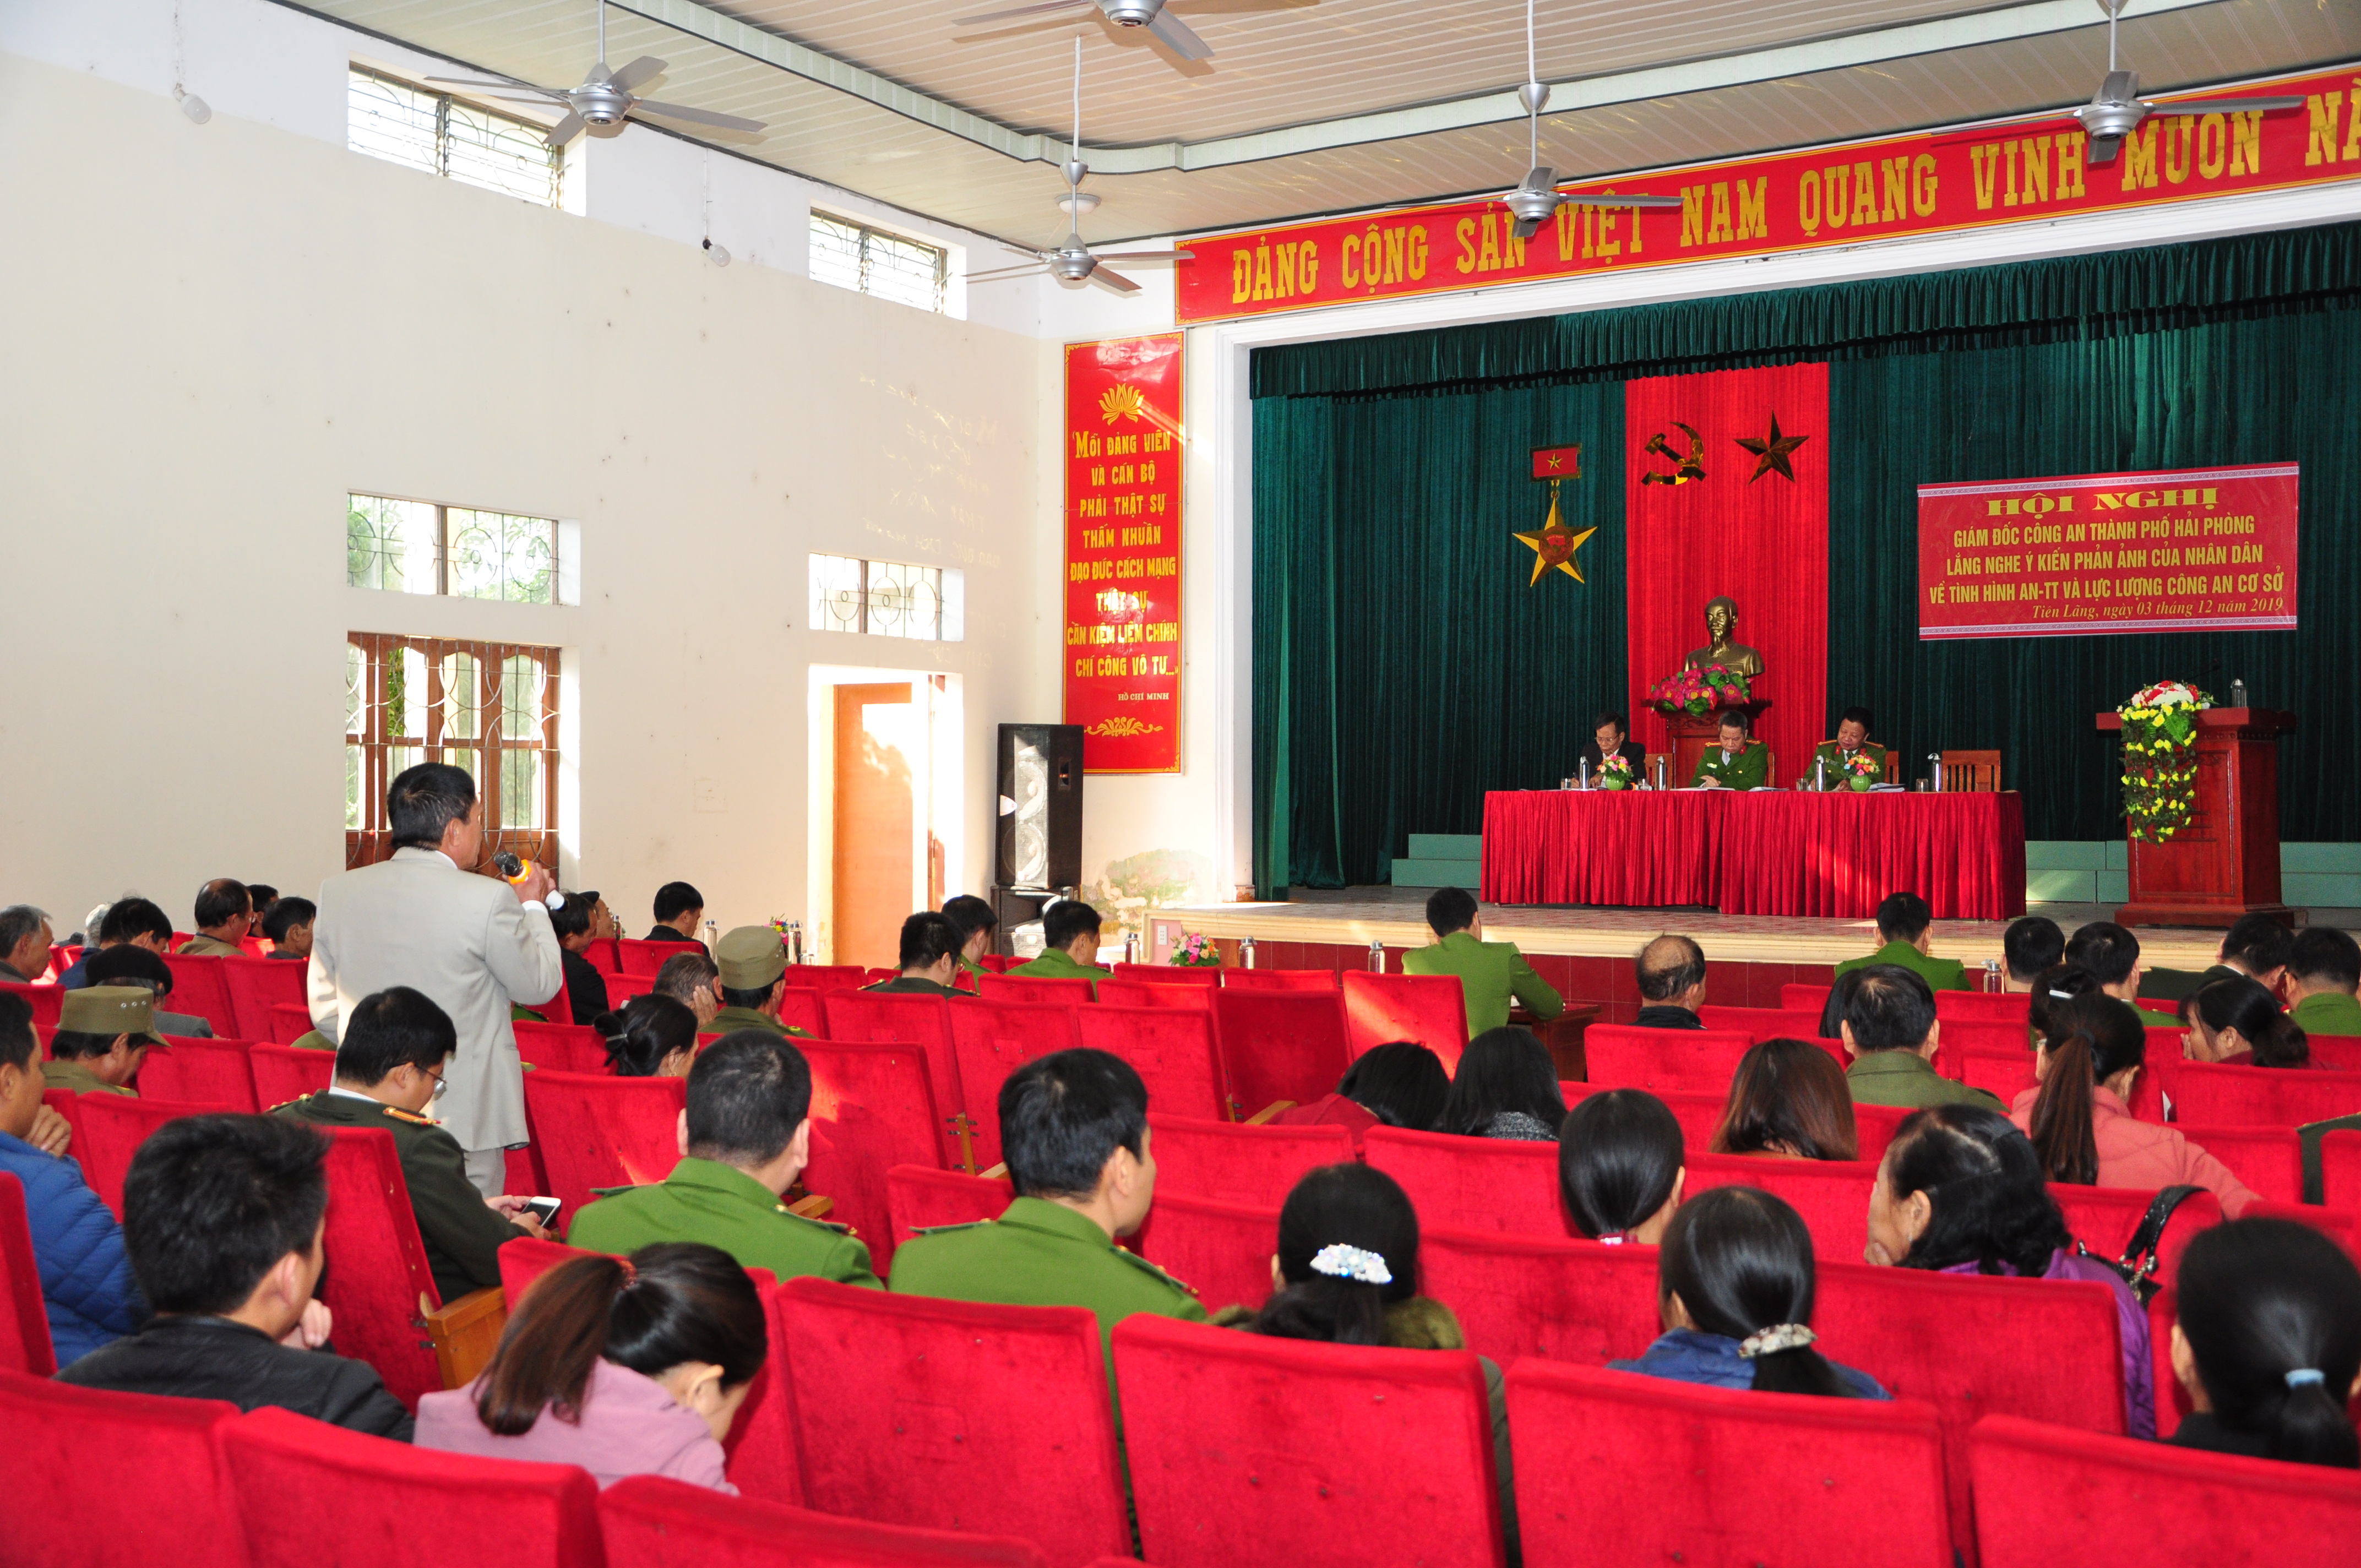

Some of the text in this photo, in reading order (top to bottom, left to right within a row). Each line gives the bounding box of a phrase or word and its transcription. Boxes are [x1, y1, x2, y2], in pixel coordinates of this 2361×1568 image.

[1233, 236, 1319, 304] ĐẢNG
[1342, 223, 1428, 293] CỘNG
[1456, 202, 1525, 274] SẢN
[1555, 188, 1649, 264] VIỆT
[1680, 176, 1767, 247] NAM
[1800, 154, 1938, 237] QUANG
[1971, 131, 2085, 210] VINH
[1107, 432, 1137, 456] ĐẢNG
[1144, 429, 1171, 453] VIÊN
[1091, 460, 1155, 486] VÀ CÁN BỘ
[1080, 492, 1167, 518] PHẢI THẬT SỰ
[1985, 487, 2219, 519] HỘI NGHỊ
[1082, 521, 1161, 548] THẤM NHUẦN
[1954, 510, 2255, 548] GIÁM ĐỐC CÔNG AN THÀNH PHỐ HẢI PHÒNG
[1070, 556, 1176, 584] ĐẠO ĐỨC CÁCH MẠNG
[1946, 541, 2263, 576] LẮNG NGHE Ý KIẾN PHẢN ẢNH CỦA NHÂN DÂN
[1929, 565, 2284, 604] VỀ TÌNH HÌNH AN-TT VÀ LỰC LƯỢNG CÔNG AN CƠ SỞ
[1096, 587, 1149, 614] THẬT SỰ
[2063, 604, 2099, 620] Lãng,
[2103, 602, 2134, 619] ngày
[2137, 601, 2152, 615] 03
[2156, 600, 2194, 617] tháng
[2198, 600, 2213, 613] 12
[2217, 599, 2246, 613] năm
[2250, 597, 2283, 612] 2019
[1067, 619, 1177, 647] CẦN KIỆM LIÊM CHÍNH
[1076, 655, 1095, 677] CHÍ
[1097, 654, 1127, 677] CÔNG
[1132, 653, 1147, 676] VÔ
[1129, 692, 1145, 701] CHÍ
[1146, 692, 1169, 700] MINH
